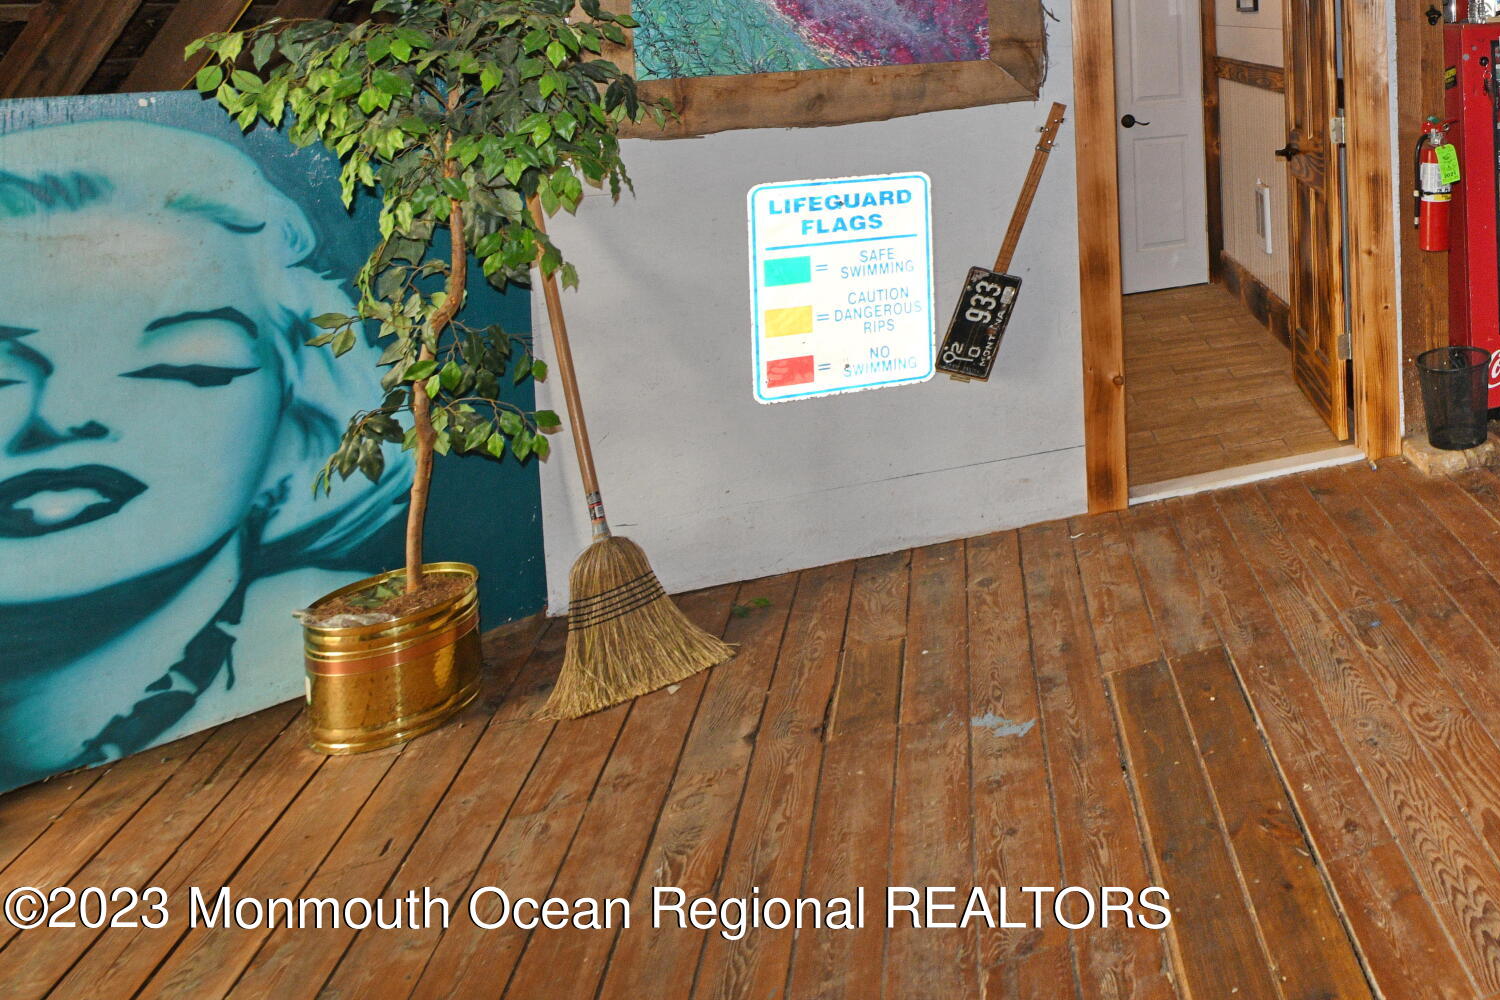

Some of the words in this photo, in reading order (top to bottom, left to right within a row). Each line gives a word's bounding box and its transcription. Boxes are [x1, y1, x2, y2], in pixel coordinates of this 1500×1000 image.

[769, 188, 913, 215] LIFEGUARD
[801, 213, 884, 236] FLAGS
[859, 247, 896, 263] SAFE
[840, 259, 915, 280] SWIMMING
[847, 286, 910, 305] CAUTION
[965, 280, 1002, 324] 933
[834, 300, 922, 323] DANGEROUS
[863, 318, 896, 334] RIPS
[869, 345, 891, 360] NO
[843, 356, 918, 378] SWIMMING
